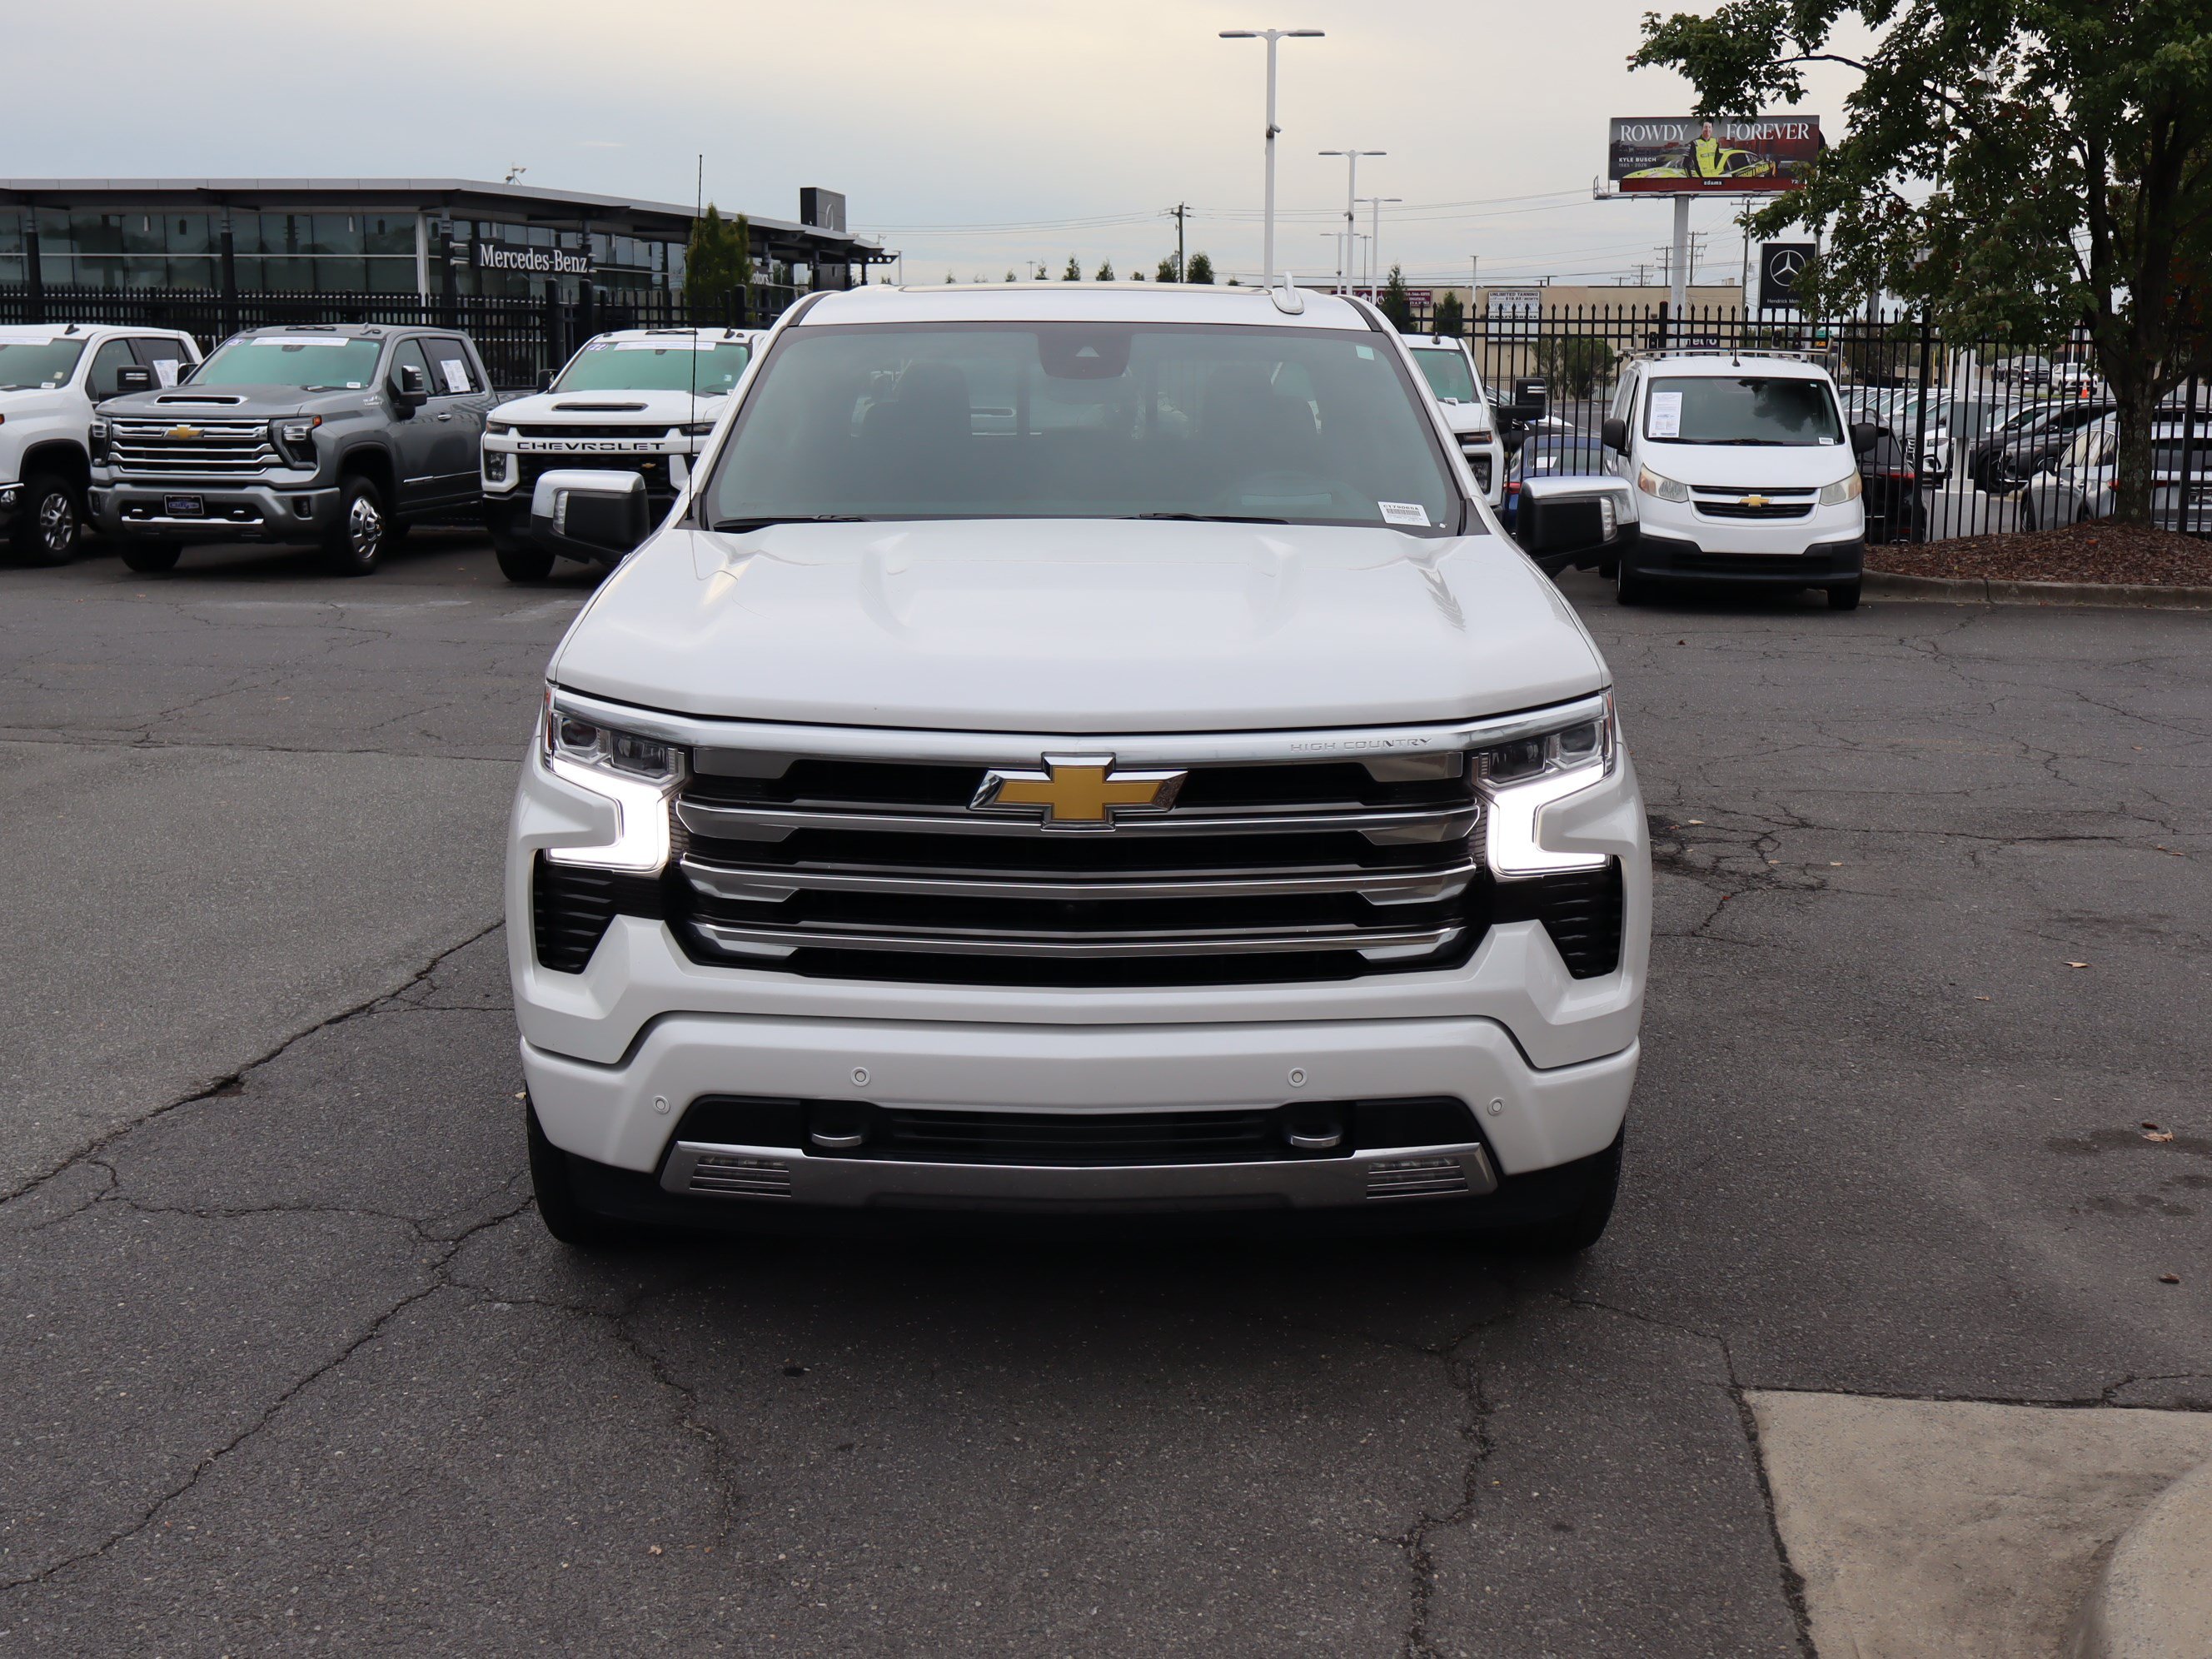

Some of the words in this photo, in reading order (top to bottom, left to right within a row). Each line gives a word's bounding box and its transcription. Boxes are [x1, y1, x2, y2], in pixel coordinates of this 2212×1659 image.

[1620, 124, 1688, 142] ROWDY
[1726, 122, 1810, 140] FOREVER
[480, 243, 588, 273] Mercedes-Benz
[516, 441, 665, 451] CHEVROLET
[1290, 742, 1336, 752] HIGH
[1343, 738, 1432, 750] COUNTRY
